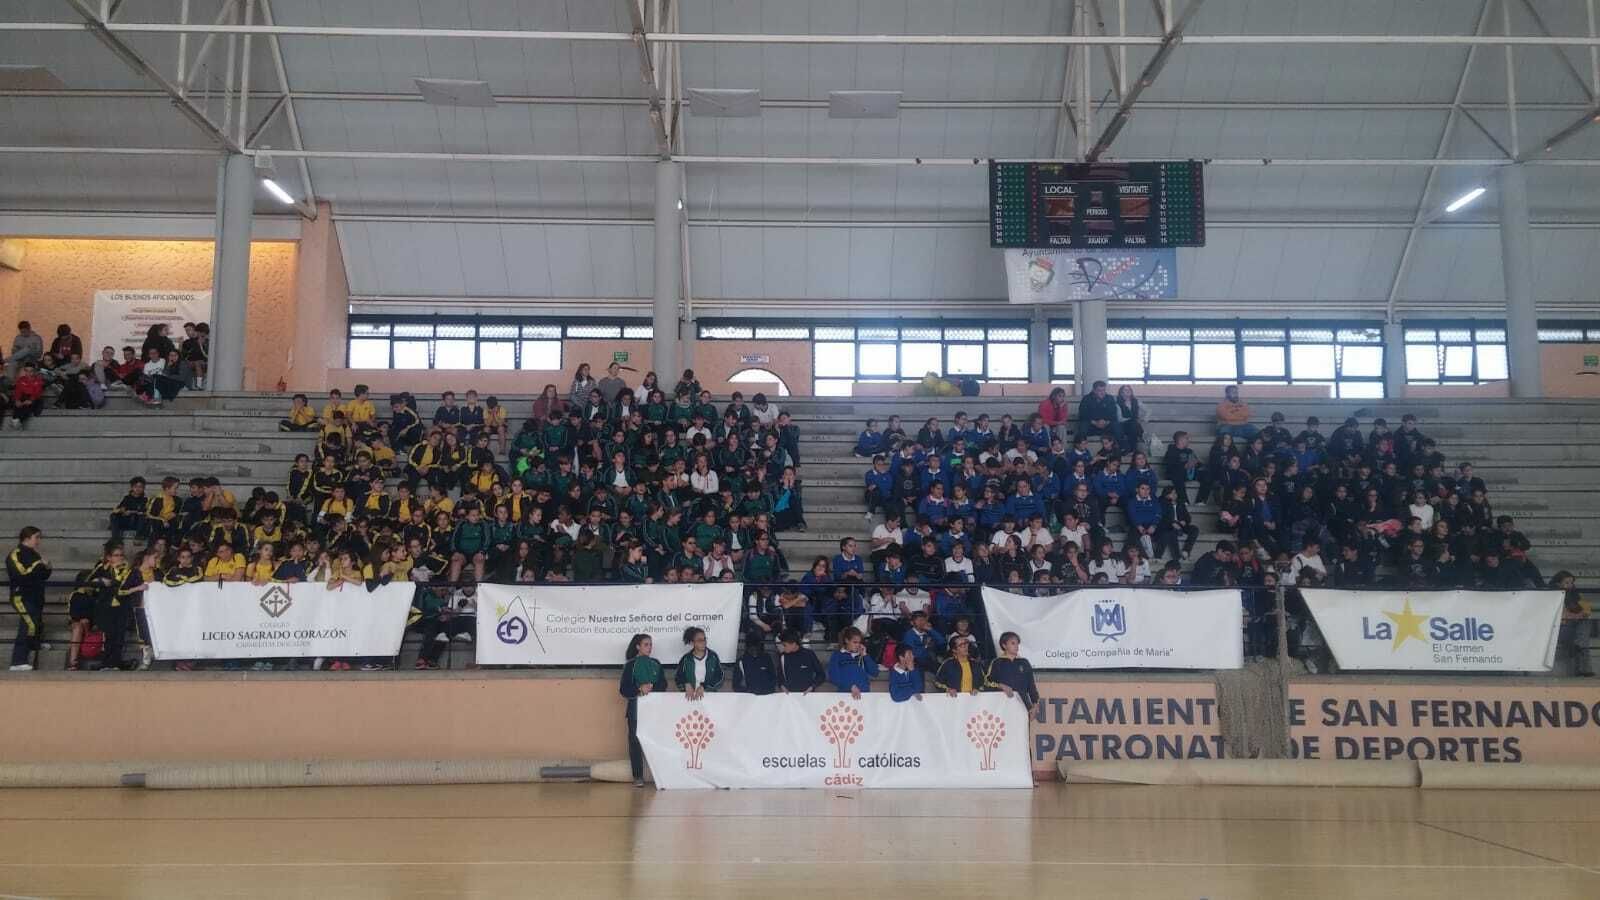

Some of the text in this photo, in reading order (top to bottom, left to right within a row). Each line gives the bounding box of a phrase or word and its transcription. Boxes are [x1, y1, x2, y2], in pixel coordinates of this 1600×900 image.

[547, 612, 724, 624] Colegio Nuestra Señora del Carmen
[202, 628, 346, 641] LICEO SAGRADO CORAZÓN
[1362, 616, 1494, 641] La Salle
[1433, 643, 1484, 652] El Carmen
[1045, 650, 1079, 660] Colegio
[1433, 654, 1503, 663] San Fernando
[1288, 699, 1306, 725] E
[1321, 698, 1398, 727] SAN
[1036, 734, 1226, 760] PATRONAT
[1335, 736, 1522, 763] DEPORTES
[763, 751, 921, 768] escuelas católicas
[824, 773, 864, 787] cádiz
